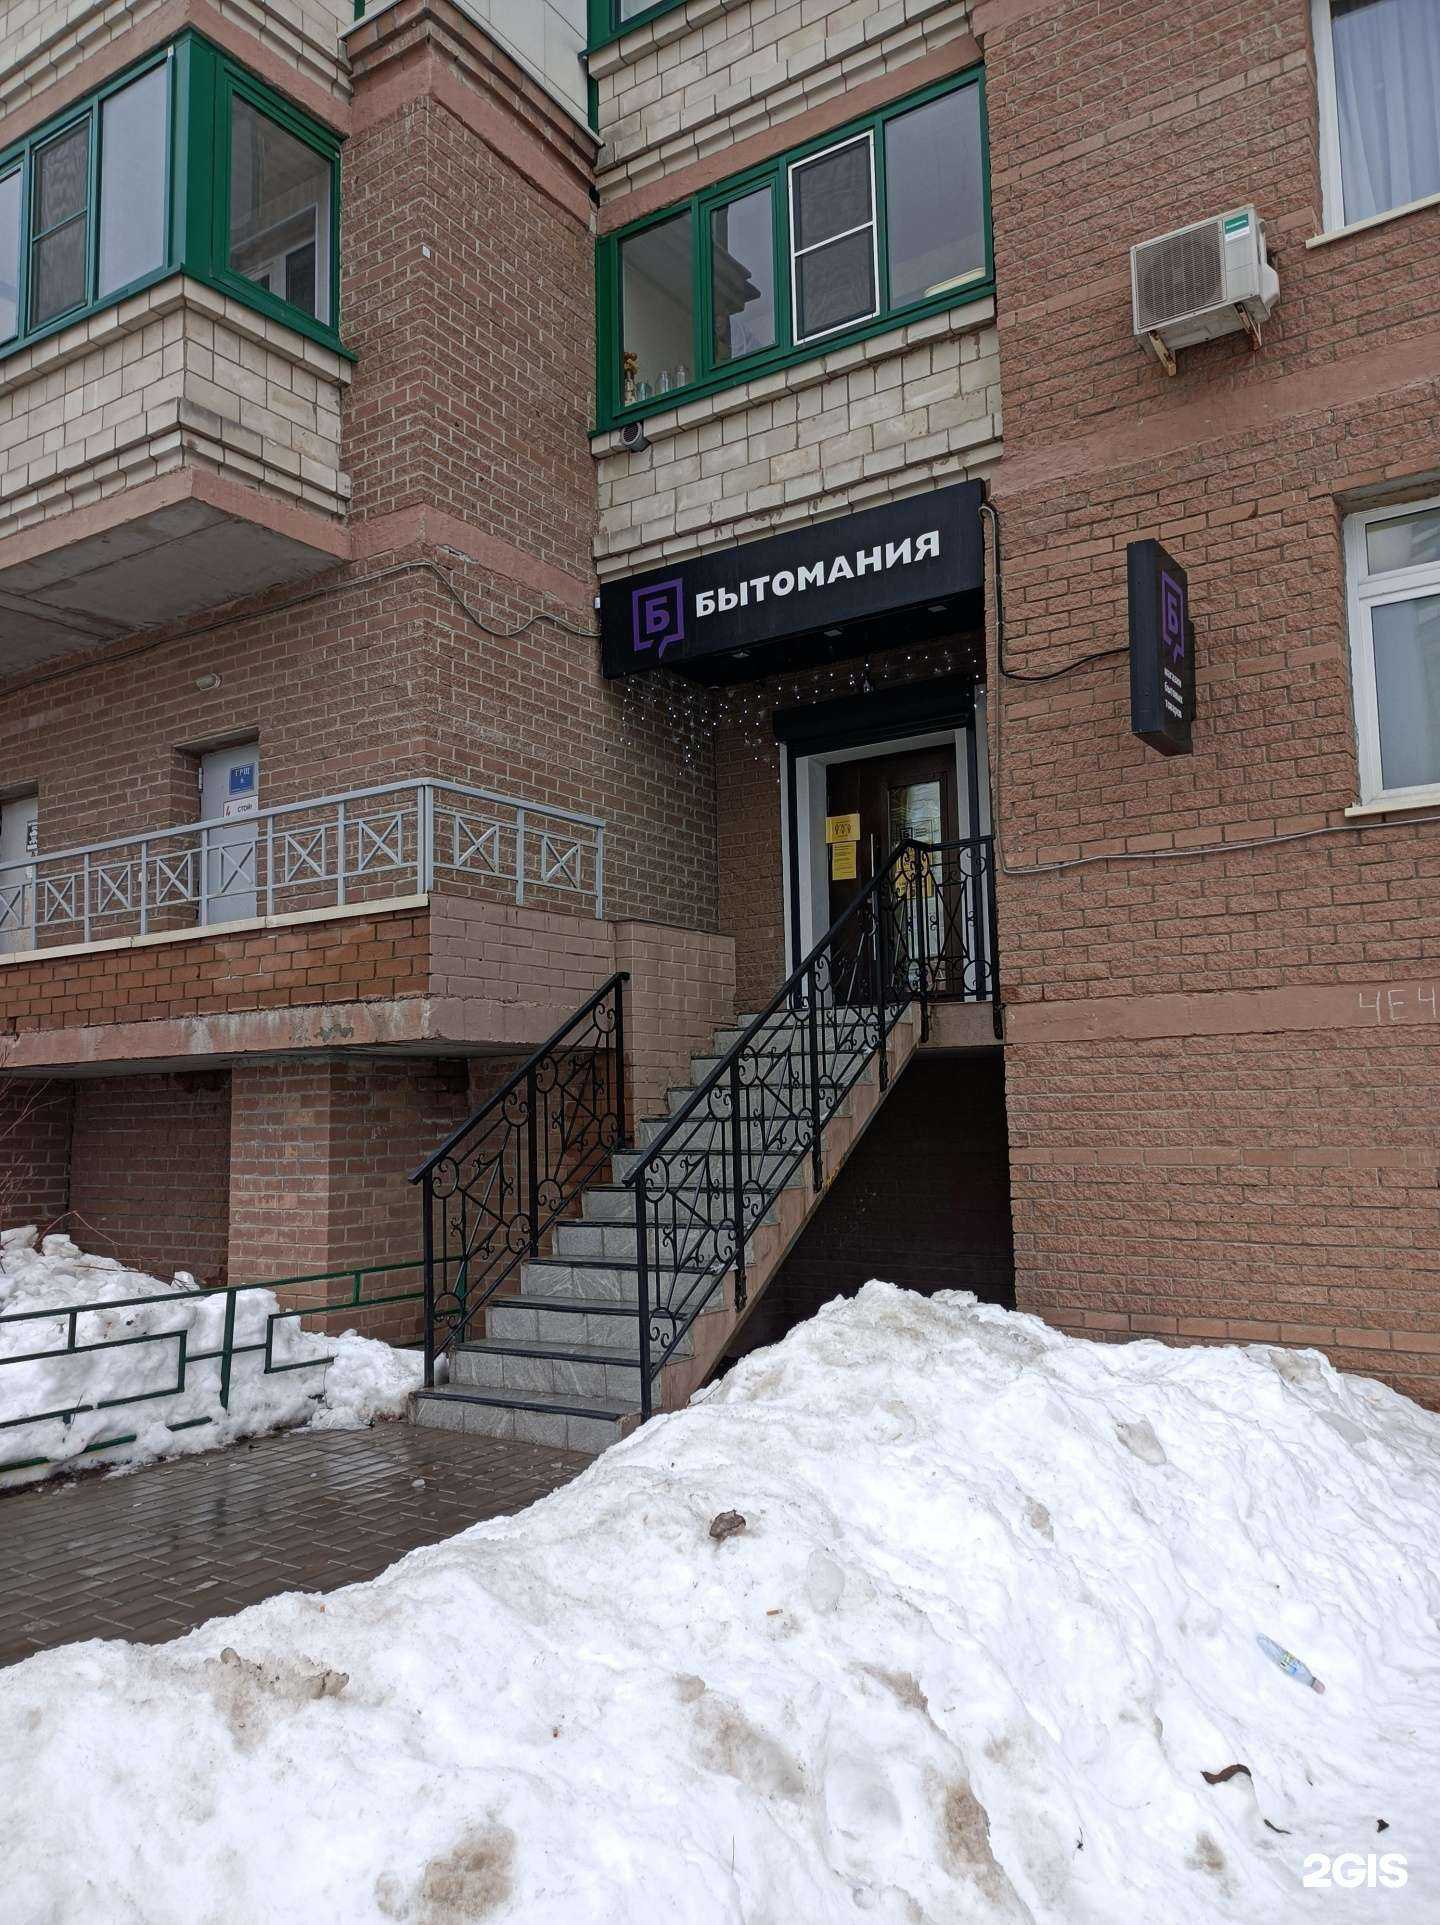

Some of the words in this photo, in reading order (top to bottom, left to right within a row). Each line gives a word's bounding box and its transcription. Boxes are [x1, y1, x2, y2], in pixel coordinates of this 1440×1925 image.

[695, 530, 941, 618] БЫТОМАНИЯ
[645, 596, 670, 634] Б
[1167, 591, 1179, 635] Б
